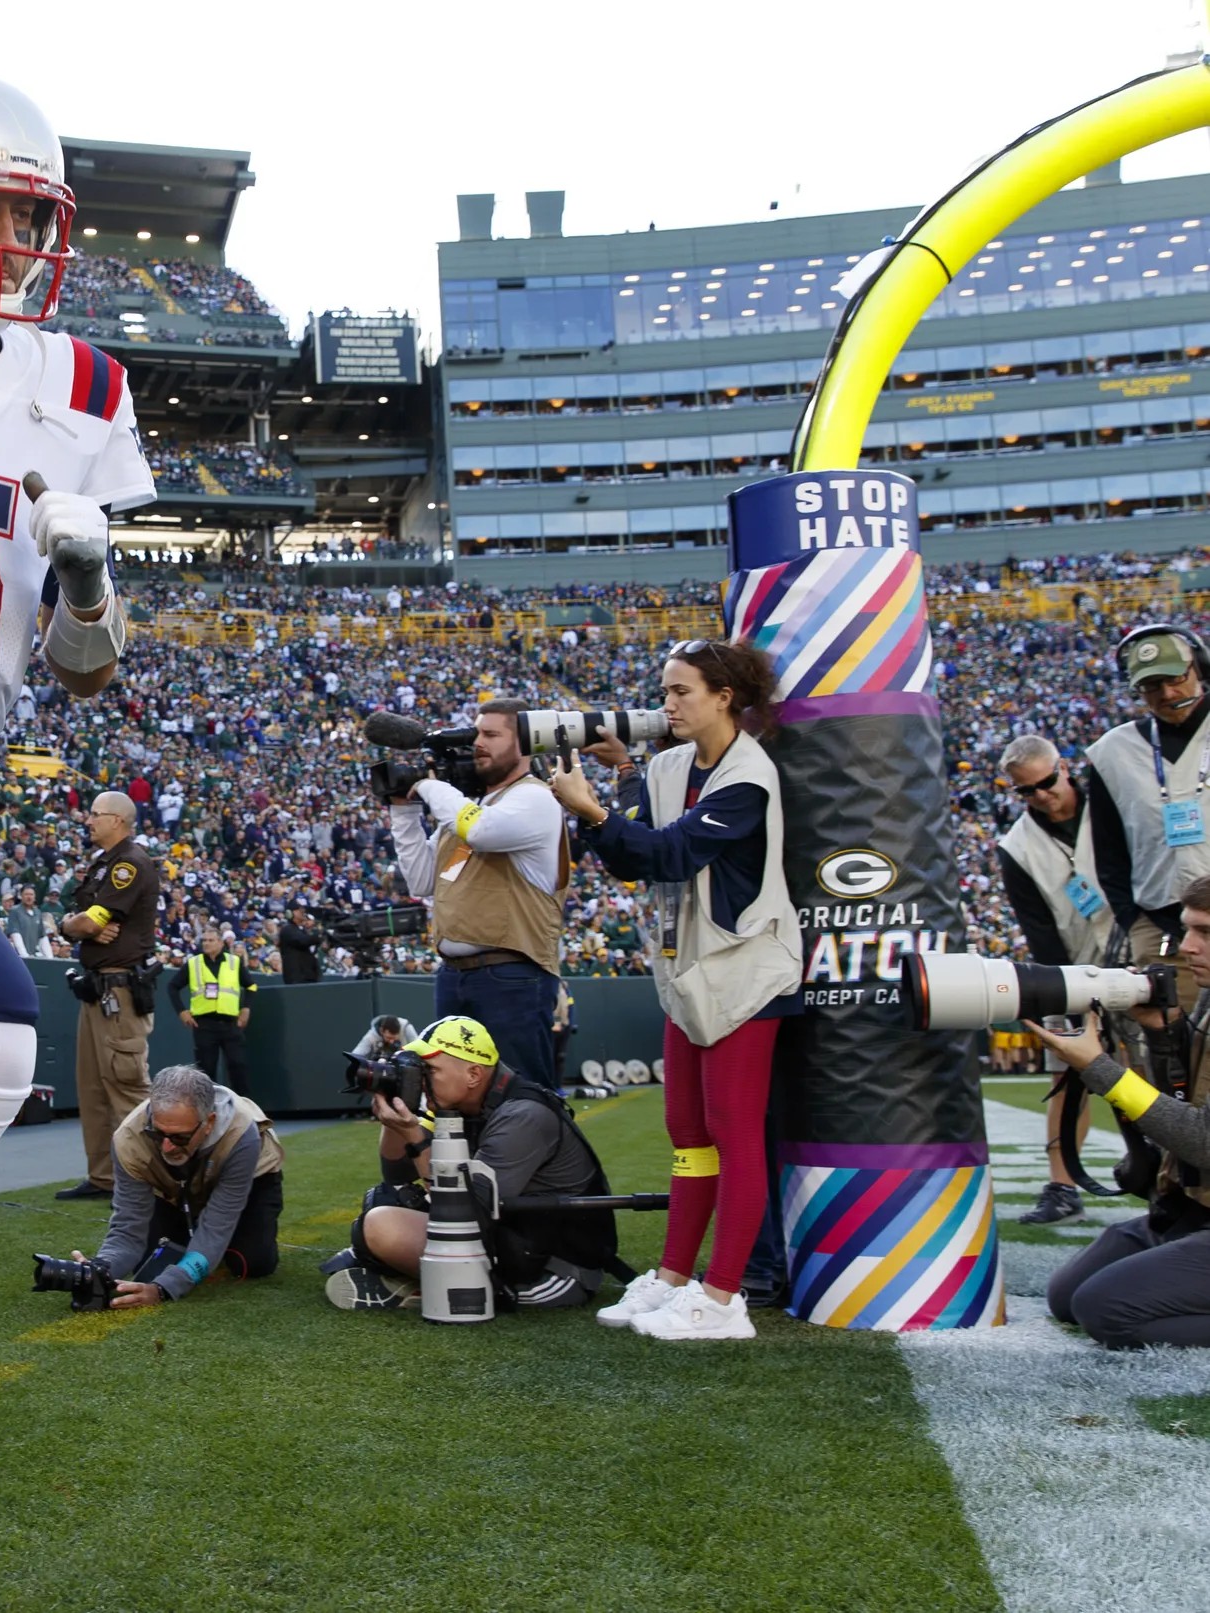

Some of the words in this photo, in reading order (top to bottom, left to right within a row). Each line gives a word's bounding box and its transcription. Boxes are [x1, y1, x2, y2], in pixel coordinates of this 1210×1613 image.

[795, 480, 908, 513] STOP
[799, 515, 910, 550] HATE
[818, 852, 896, 898] G
[798, 903, 924, 929] CRUCIAL
[804, 989, 865, 1005] RCEPT
[875, 988, 900, 1004] CA
